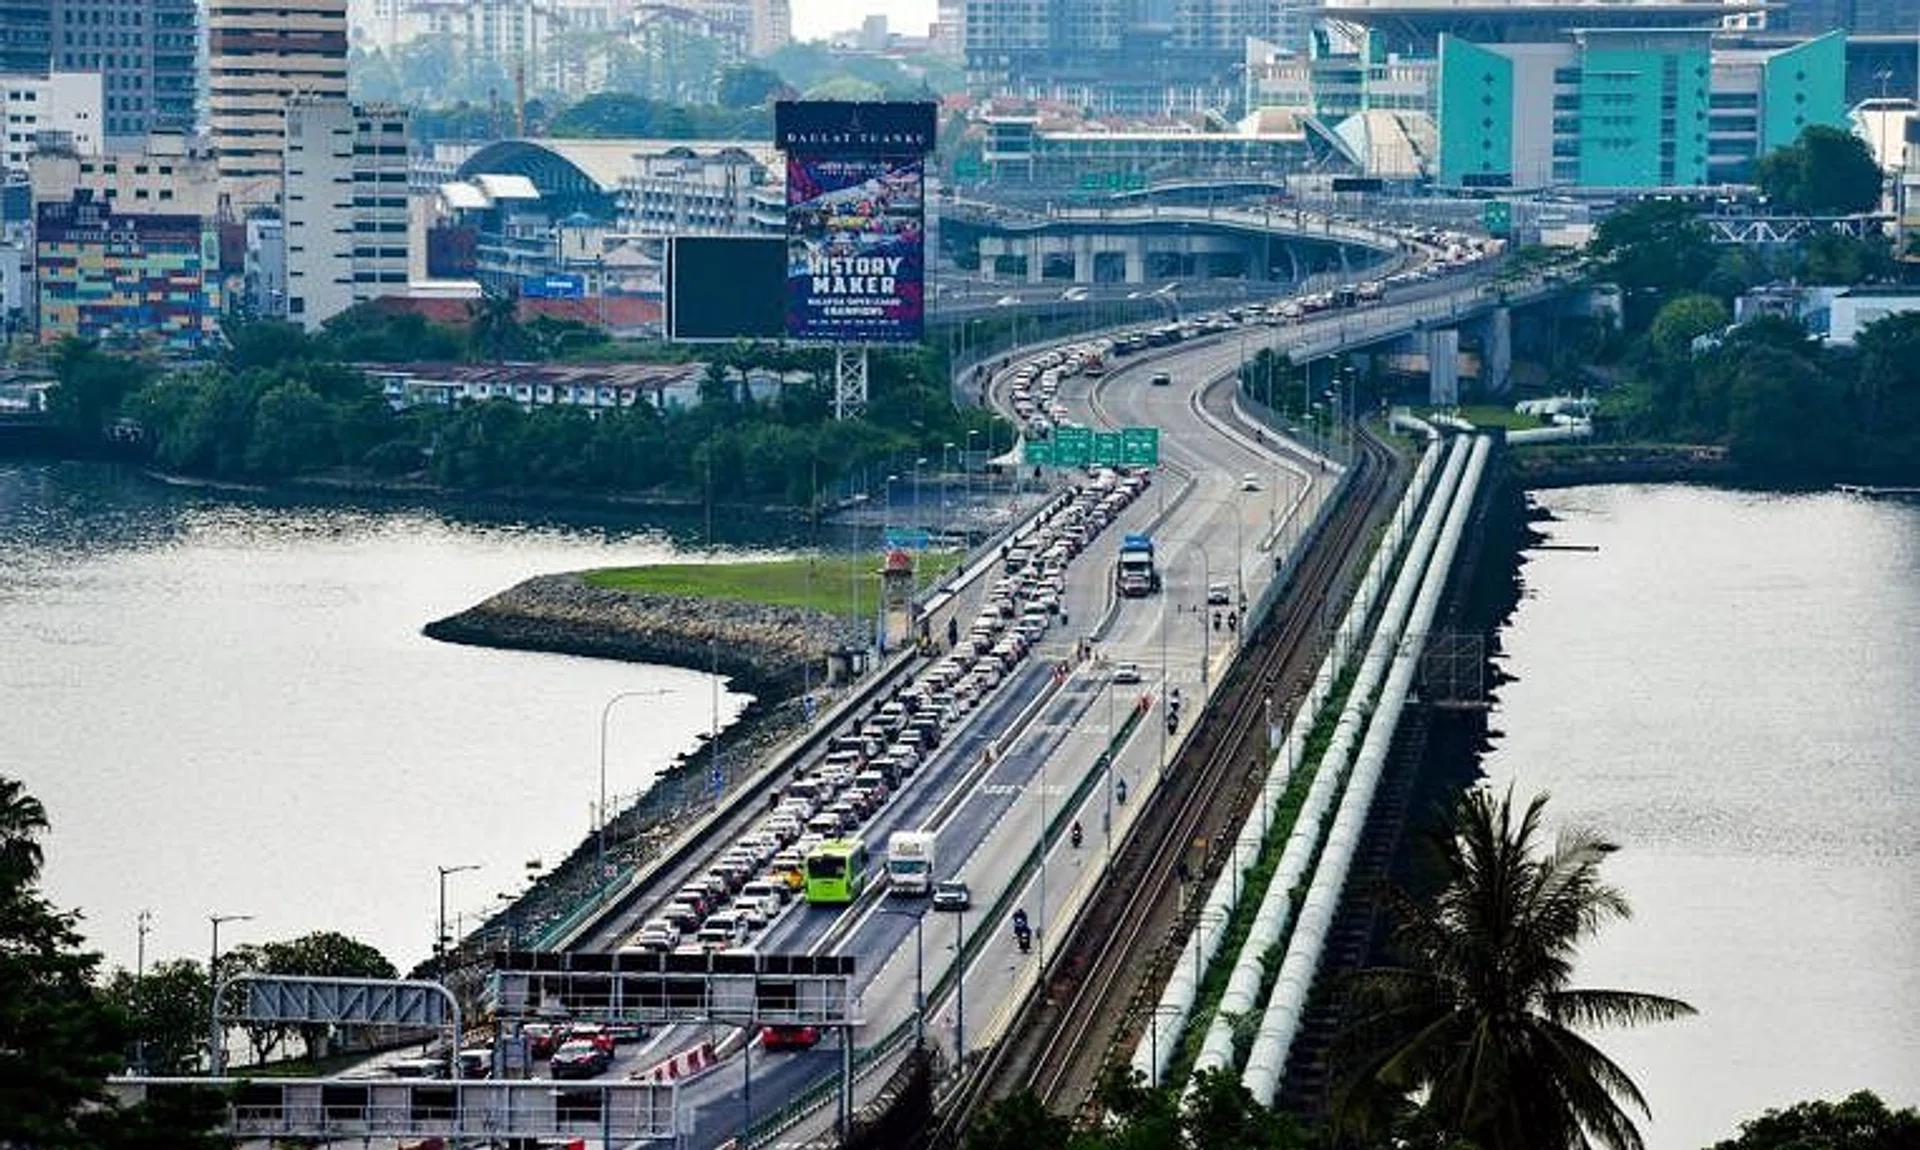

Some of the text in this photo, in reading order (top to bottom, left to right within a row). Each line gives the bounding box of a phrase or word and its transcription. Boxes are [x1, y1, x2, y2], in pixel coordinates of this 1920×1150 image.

[787, 132, 850, 143] DAULAT
[807, 256, 904, 275] HISTORY
[812, 276, 895, 294] MAKER
